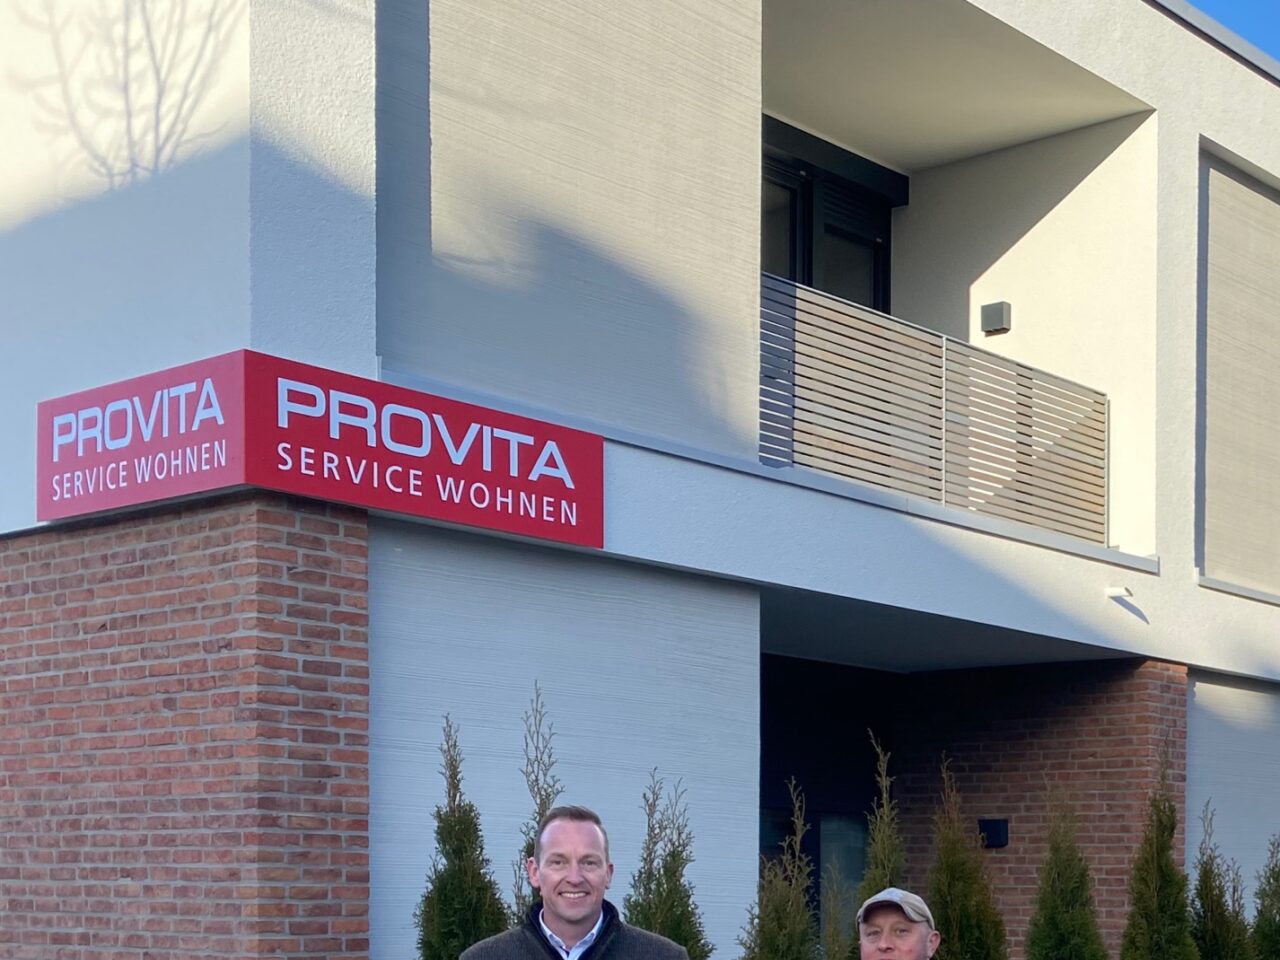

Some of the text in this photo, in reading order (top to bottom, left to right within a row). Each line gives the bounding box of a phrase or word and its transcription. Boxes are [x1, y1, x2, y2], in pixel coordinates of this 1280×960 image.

[52, 377, 225, 463] PROVITA
[277, 377, 575, 490] PROVITA
[51, 439, 227, 501] SERVICE WOHNEN
[277, 442, 577, 526] SERVICE WOHNEN
